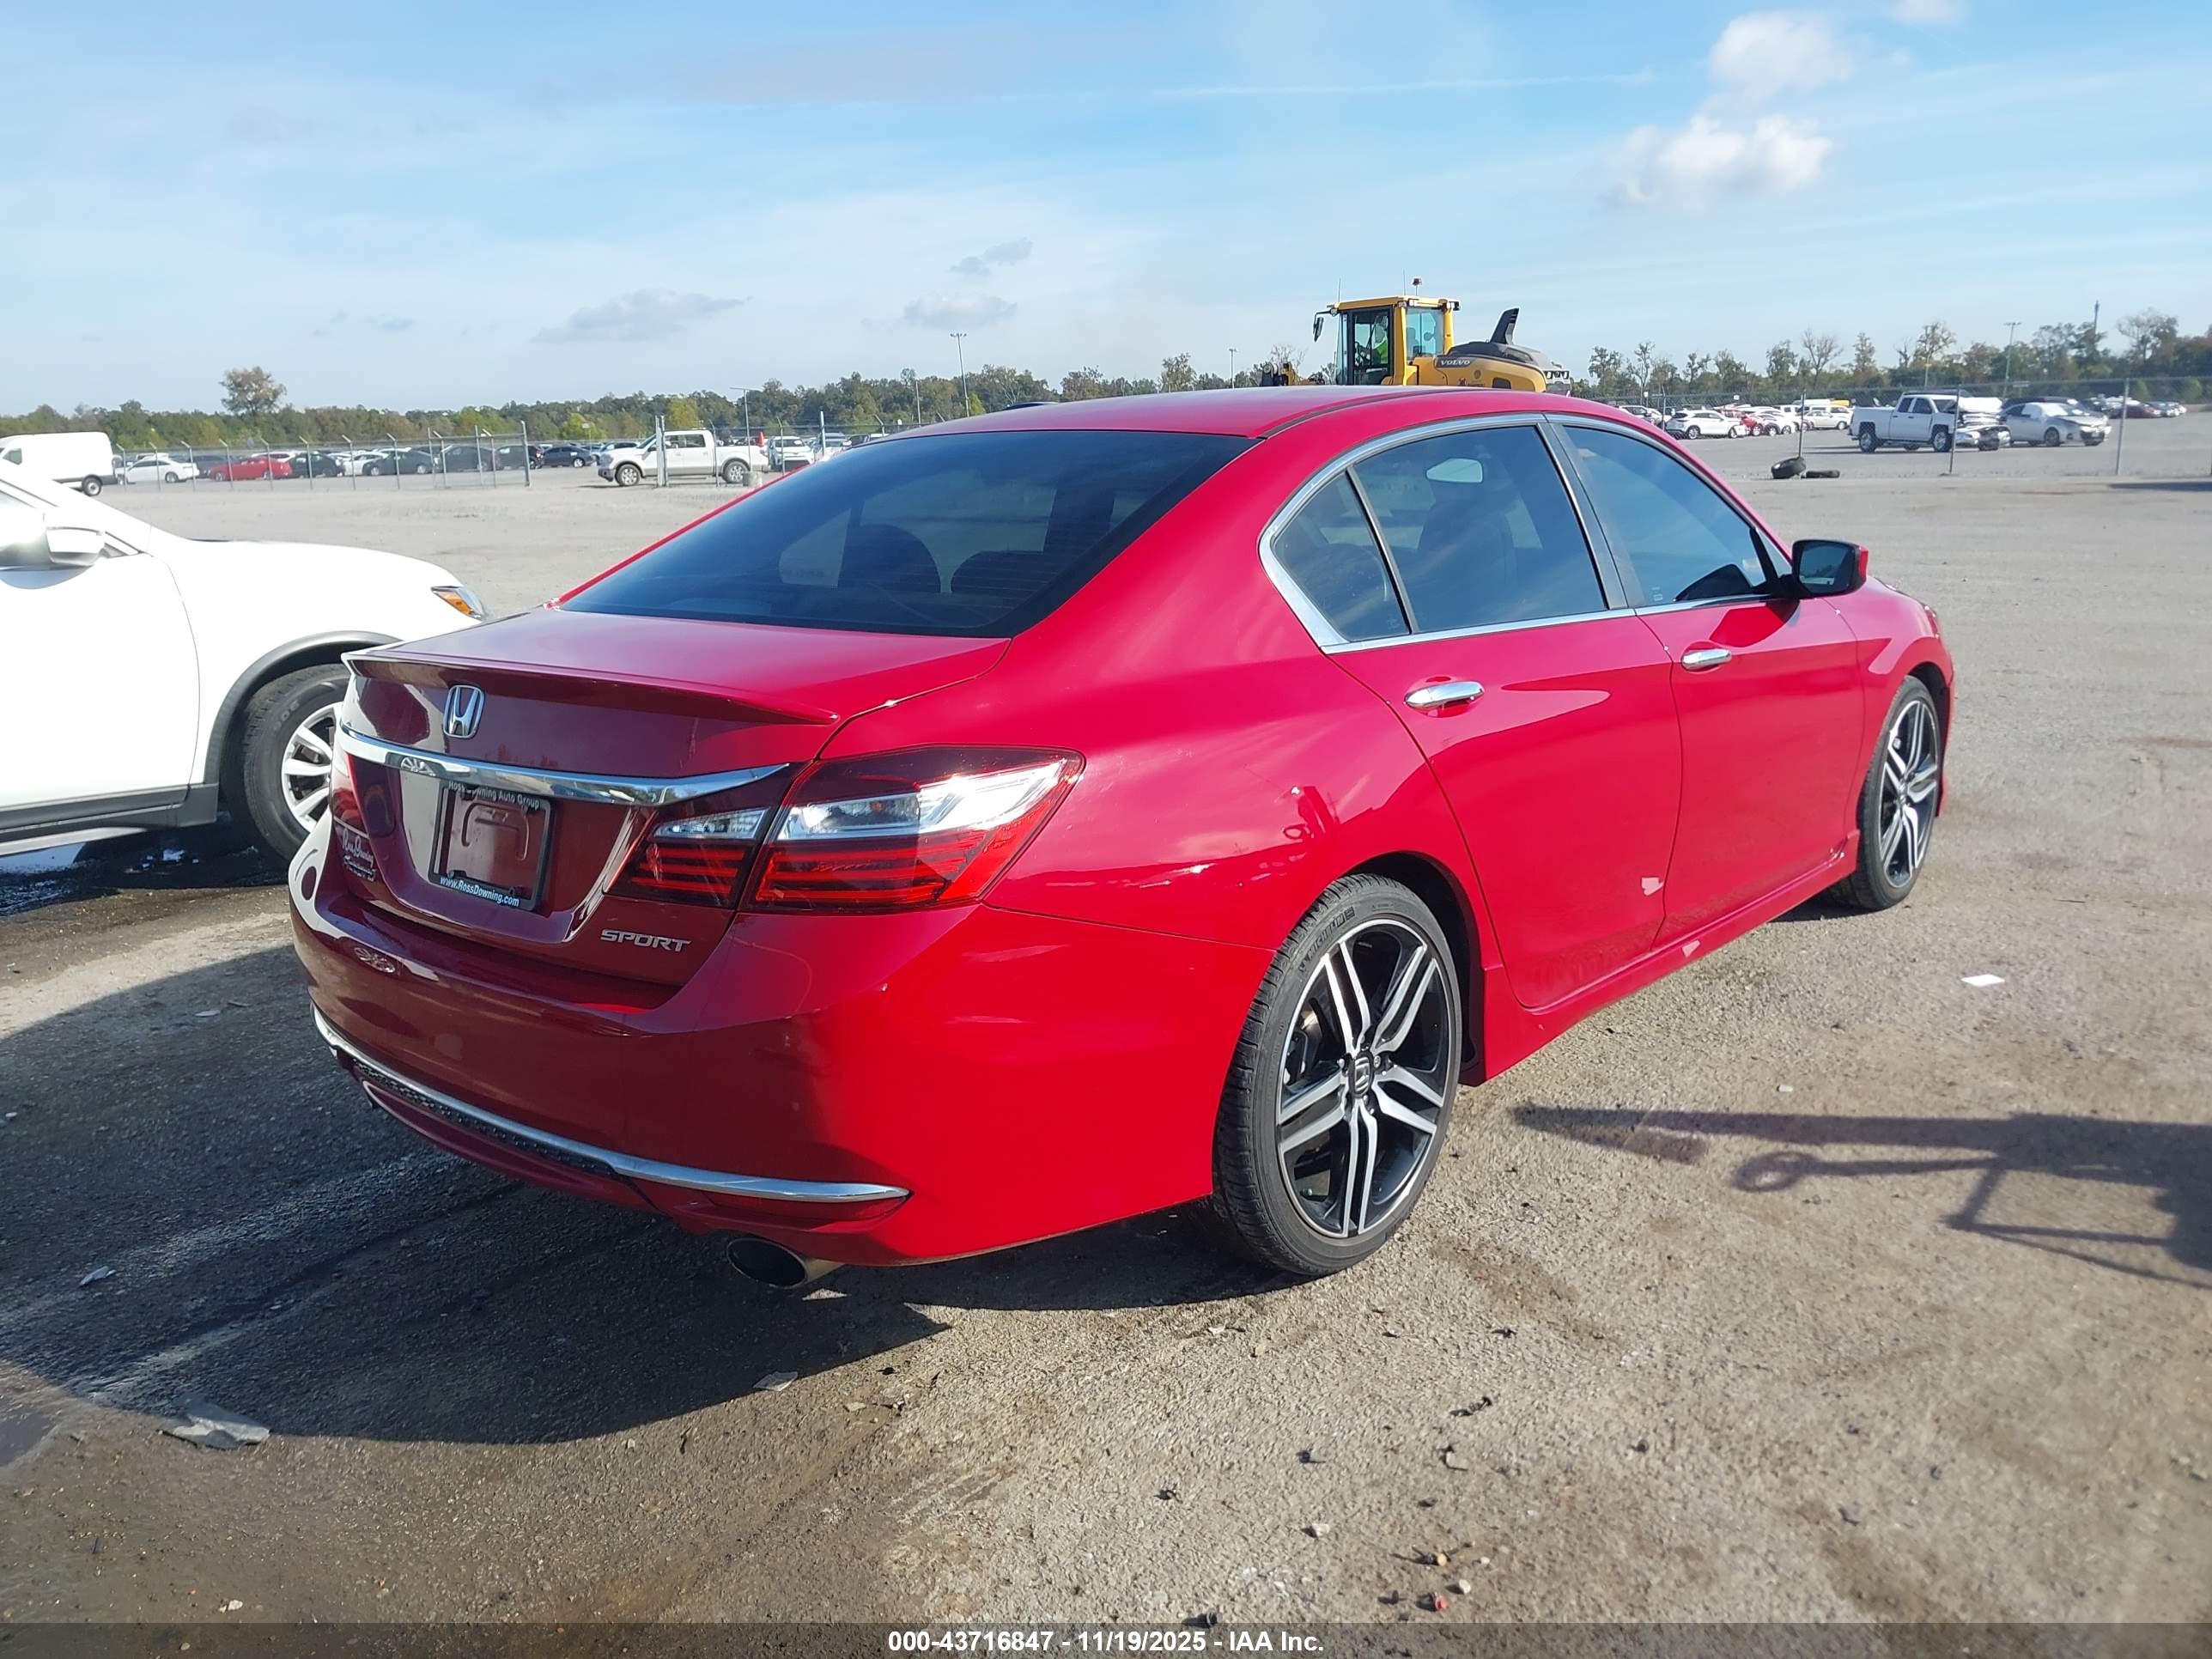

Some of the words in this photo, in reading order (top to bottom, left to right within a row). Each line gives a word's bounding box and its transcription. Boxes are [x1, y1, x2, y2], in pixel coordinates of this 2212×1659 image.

[498, 789, 515, 804] Auto
[517, 793, 540, 811] Group
[440, 876, 520, 907] www.RossDowning.com
[600, 928, 691, 952] SPORT
